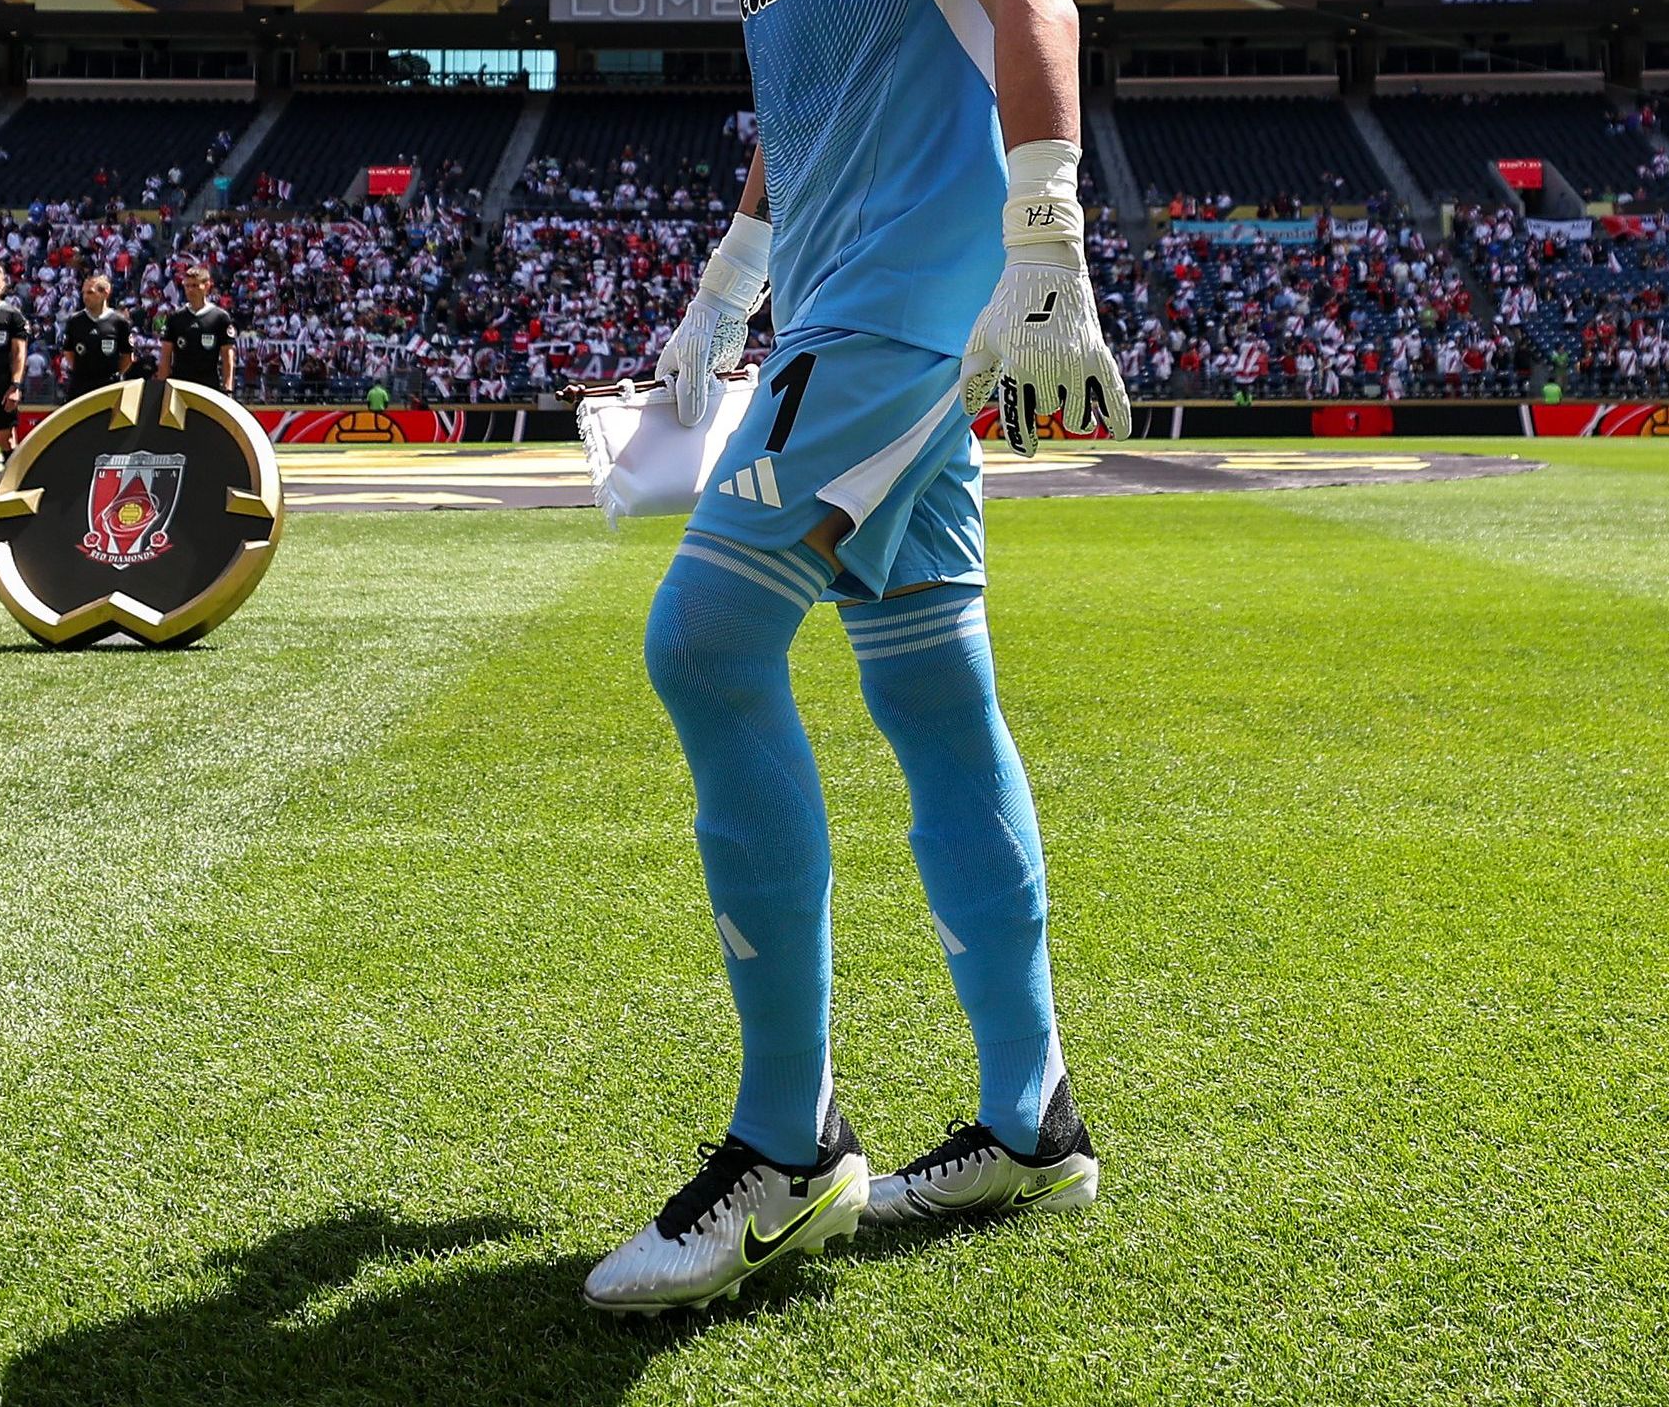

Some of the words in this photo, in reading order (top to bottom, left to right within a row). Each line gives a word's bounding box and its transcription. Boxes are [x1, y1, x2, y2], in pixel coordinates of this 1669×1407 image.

[764, 352, 817, 453] 1
[1000, 374, 1027, 453] reusch
[98, 470, 177, 479] URAWA
[90, 550, 107, 561] RED
[108, 551, 156, 563] DIAMONDS
